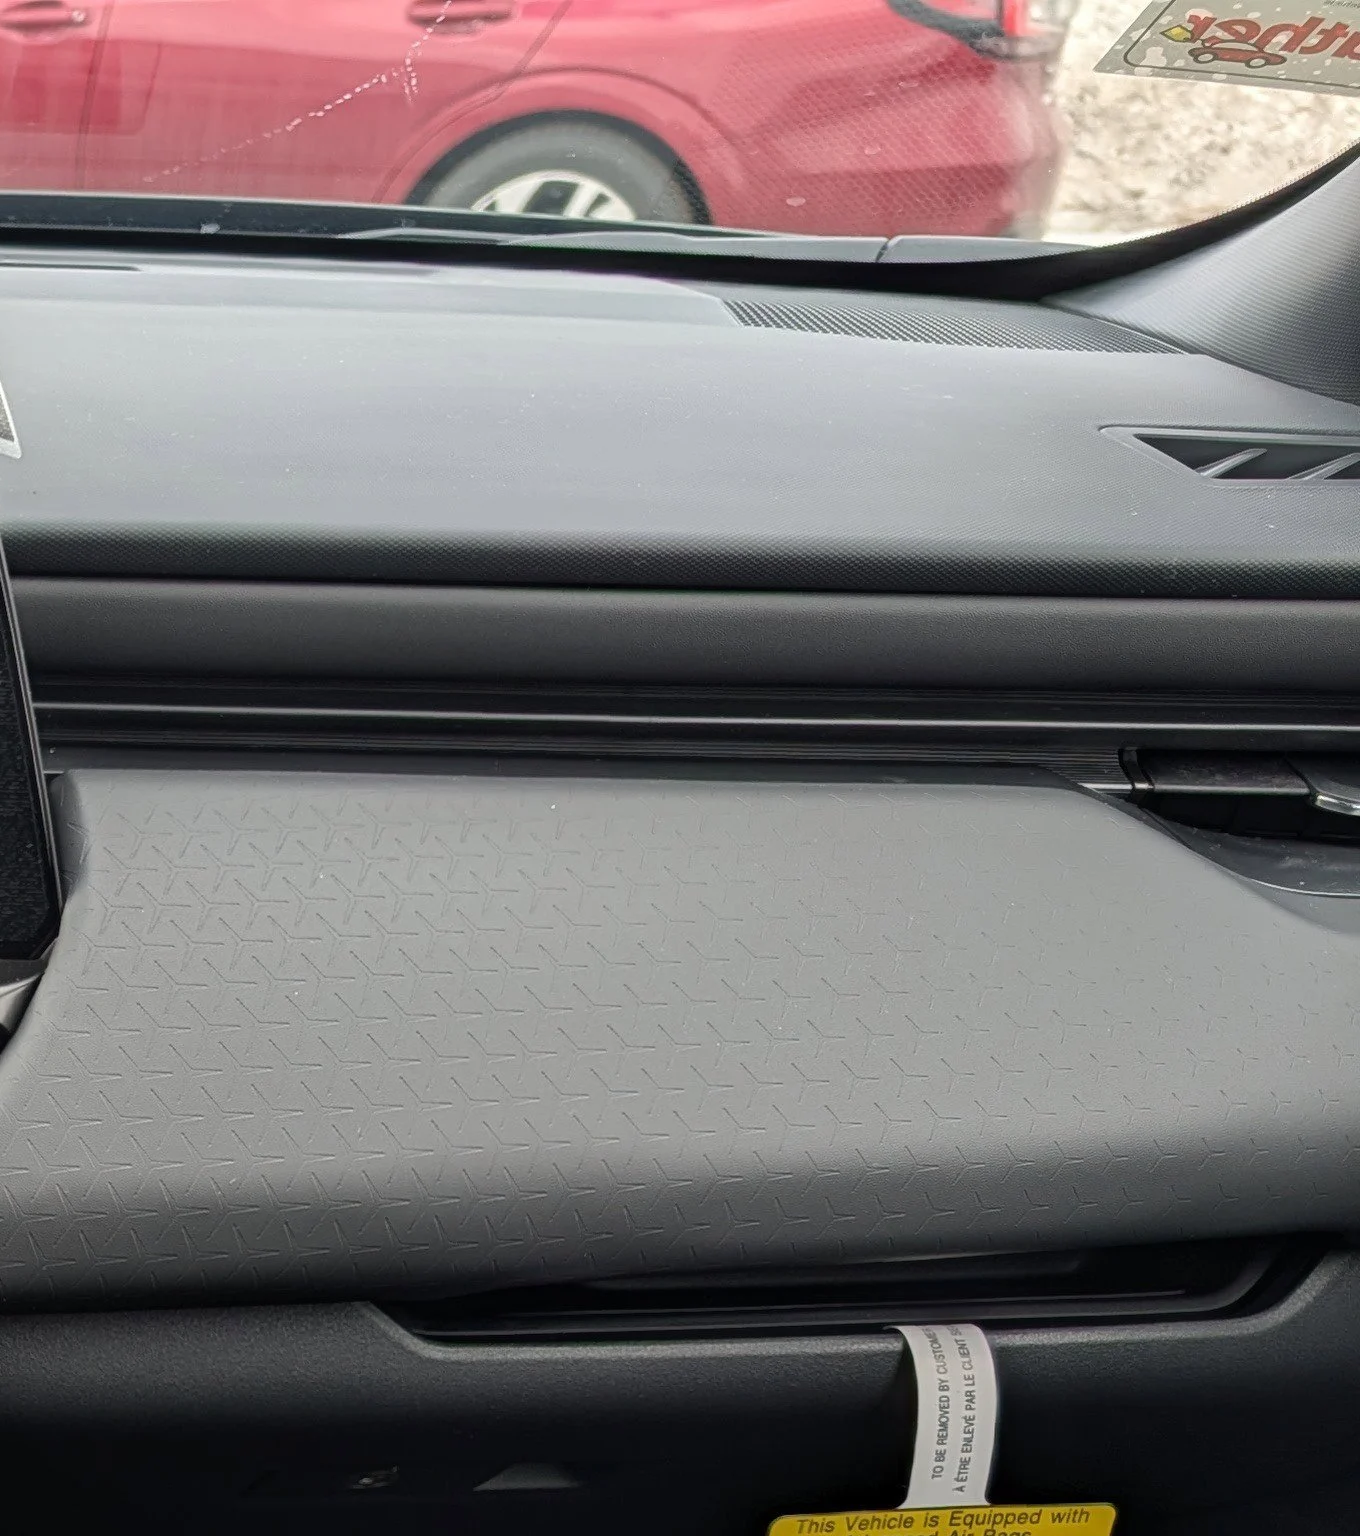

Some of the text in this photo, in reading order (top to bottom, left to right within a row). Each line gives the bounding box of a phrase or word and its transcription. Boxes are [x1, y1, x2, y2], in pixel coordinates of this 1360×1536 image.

[955, 1337, 975, 1371] CLIENT
[938, 1377, 950, 1392] BY
[964, 1374, 975, 1388] LE
[964, 1389, 976, 1411] PAR
[936, 1396, 950, 1446] REMOVED
[934, 1448, 947, 1463] BE
[931, 1465, 944, 1480] TO
[796, 1508, 1091, 1535] This Vehicle is Equipped with
